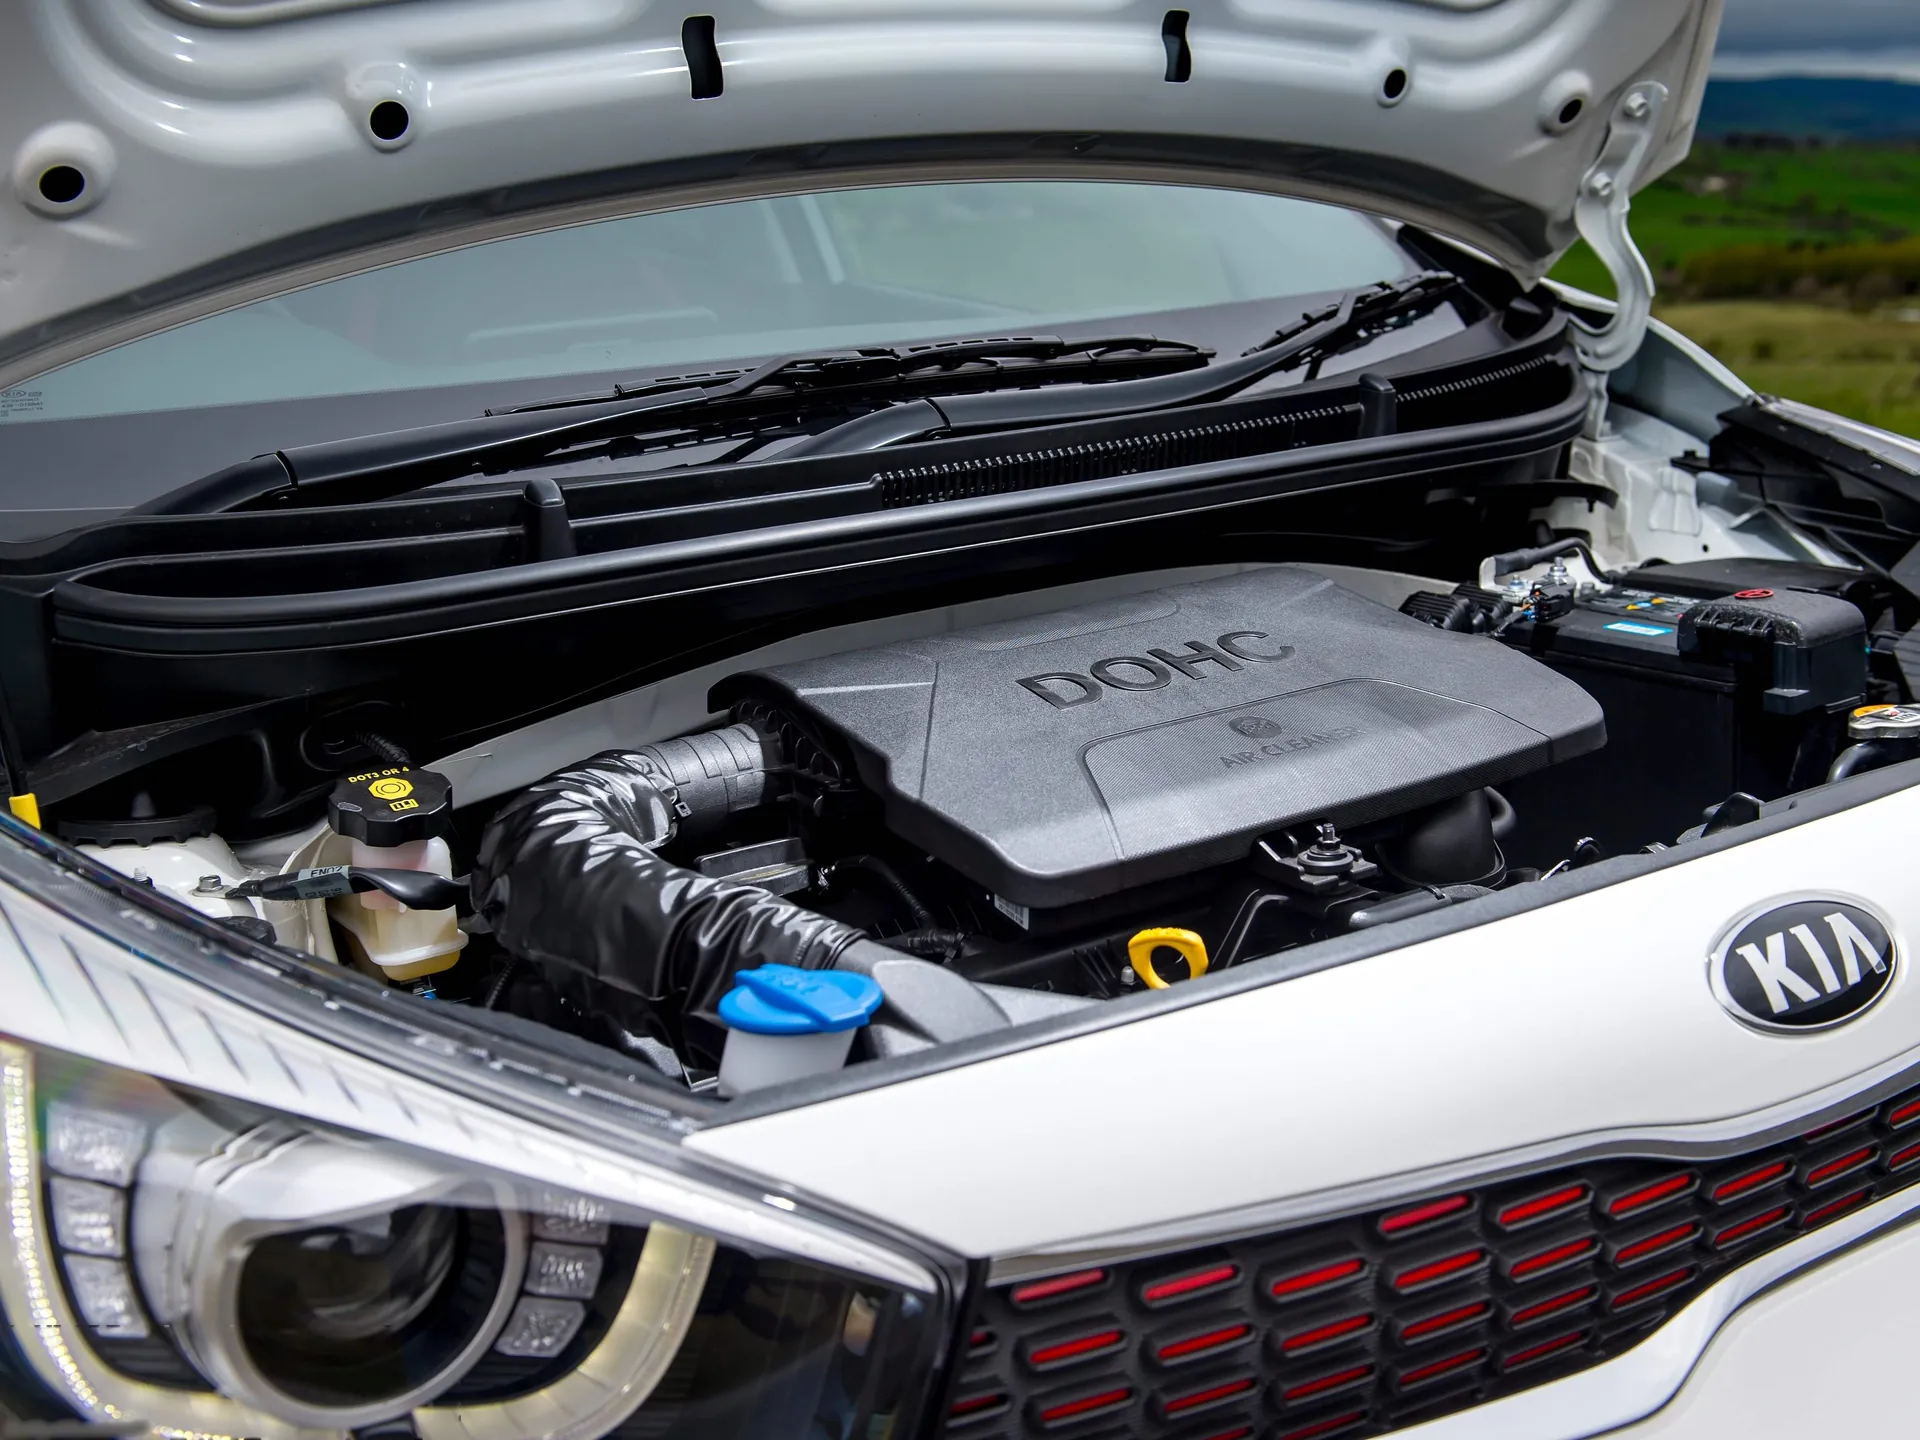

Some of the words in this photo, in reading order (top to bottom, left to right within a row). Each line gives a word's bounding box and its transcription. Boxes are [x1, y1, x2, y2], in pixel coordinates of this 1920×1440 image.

[1015, 631, 1296, 710] DOHC
[347, 772, 380, 783] DOT3
[382, 768, 400, 776] OR
[1219, 752, 1264, 769] AIR
[1735, 912, 1887, 1014] KIA
